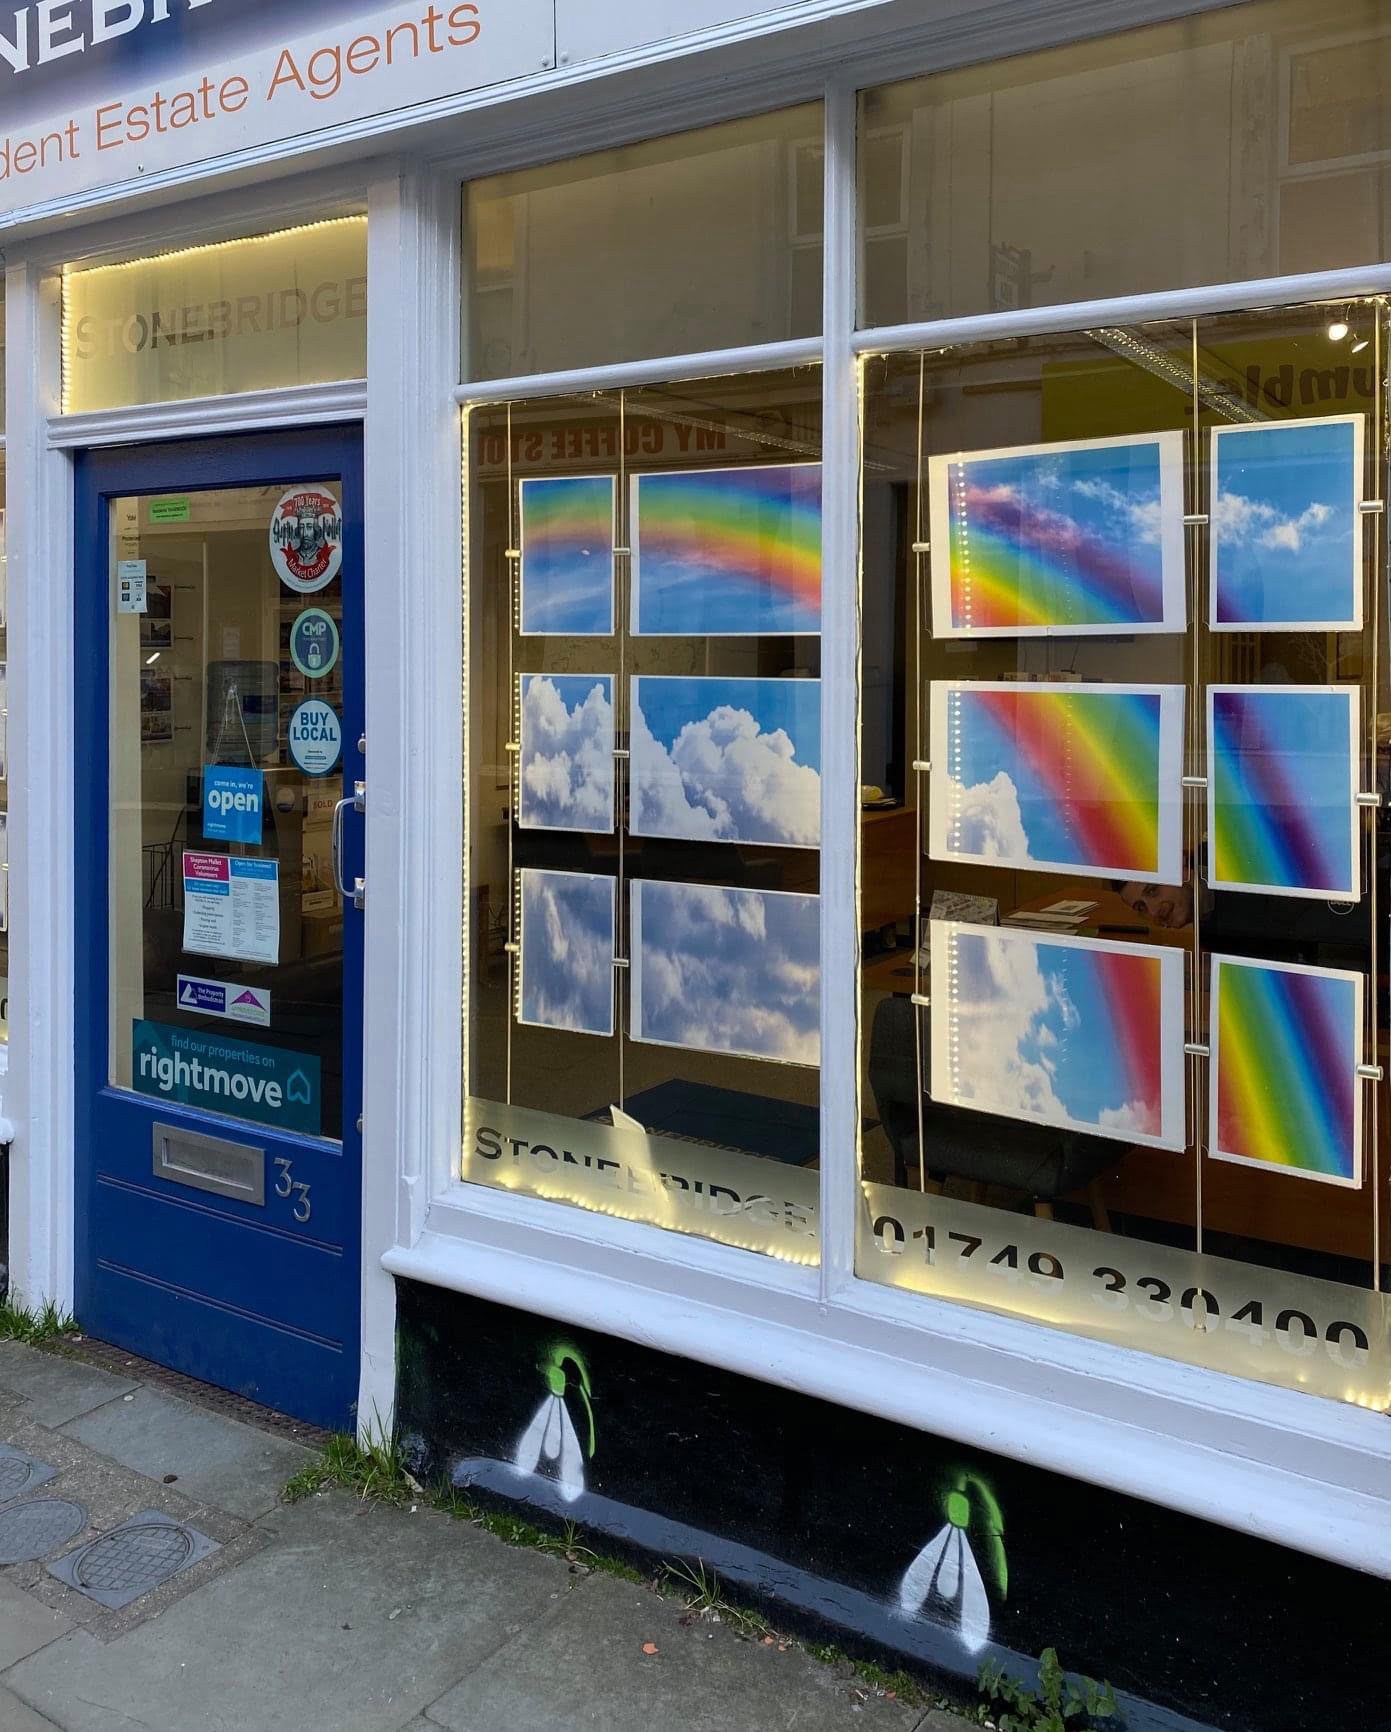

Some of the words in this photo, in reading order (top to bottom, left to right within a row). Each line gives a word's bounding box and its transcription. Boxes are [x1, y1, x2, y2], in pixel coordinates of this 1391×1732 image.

[0, 0, 212, 73] NEB
[0, 120, 80, 180] dent
[96, 76, 249, 150] Estate
[267, 2, 482, 101] Agents
[76, 276, 367, 360] STONEBRIDGE
[288, 558, 307, 578] Market
[308, 559, 327, 577] Charter
[302, 622, 326, 636] CMP
[293, 727, 337, 741] LOCAL
[300, 712, 328, 726] BUY
[208, 789, 258, 816] open
[171, 1035, 189, 1049] find
[190, 1041, 206, 1053] our
[208, 1045, 260, 1066] properties
[262, 1057, 276, 1068] on
[140, 1046, 283, 1108] rightmove
[274, 1157, 311, 1223] 33
[872, 1215, 1064, 1295] 01749
[1092, 1266, 1369, 1369] 330400
